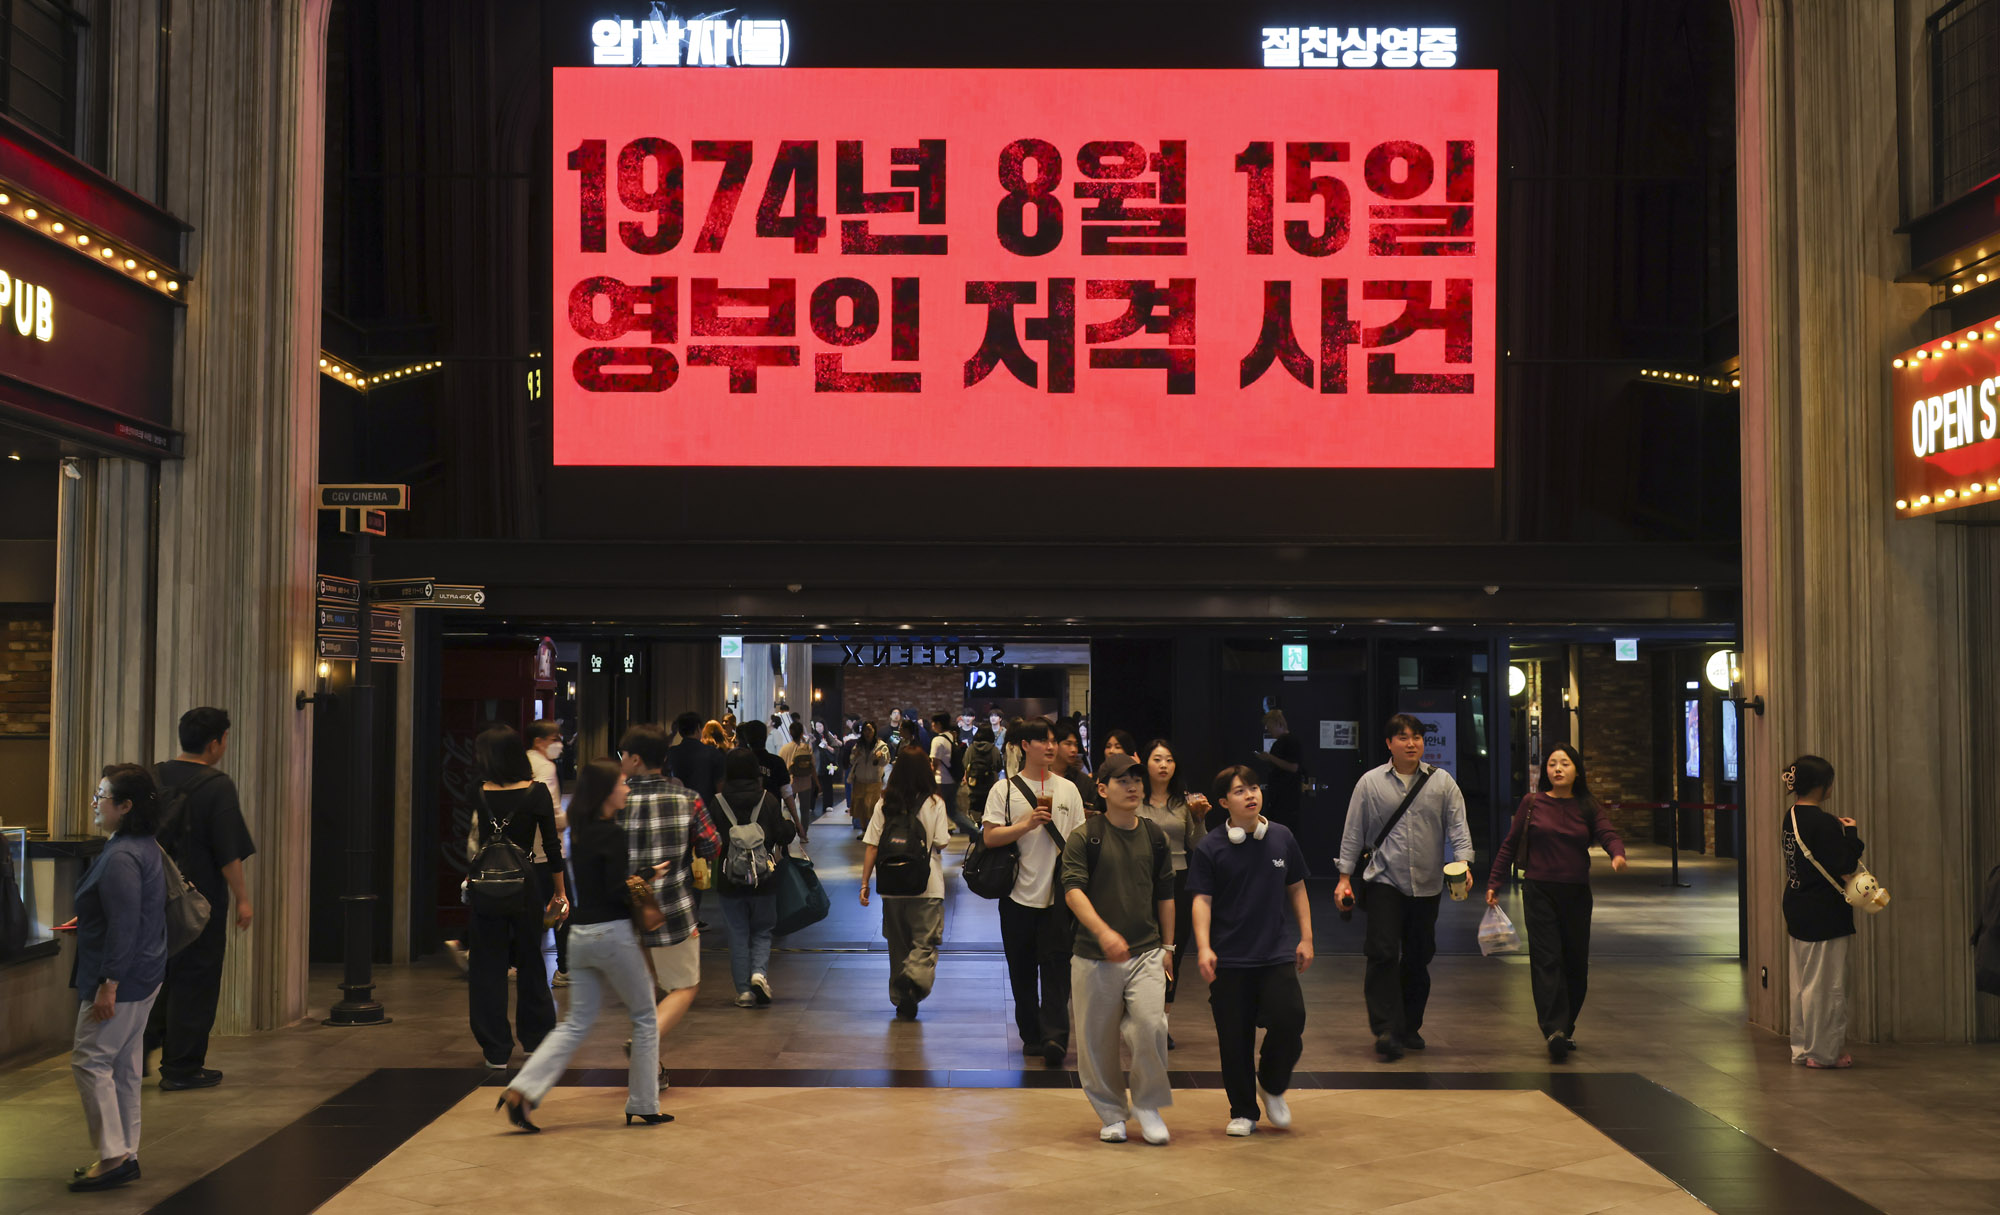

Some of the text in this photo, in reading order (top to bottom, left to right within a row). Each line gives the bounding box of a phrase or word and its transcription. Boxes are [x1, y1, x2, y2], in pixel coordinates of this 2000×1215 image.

[592, 19, 789, 66] 암살자(들)
[1262, 27, 1457, 67] 절찬상영중
[567, 137, 1476, 257] 1974년 8월 15일
[568, 275, 1474, 394] 영부인 저격 사건
[1912, 385, 1973, 458] OPEN
[332, 491, 388, 501] CGV CINEMA
